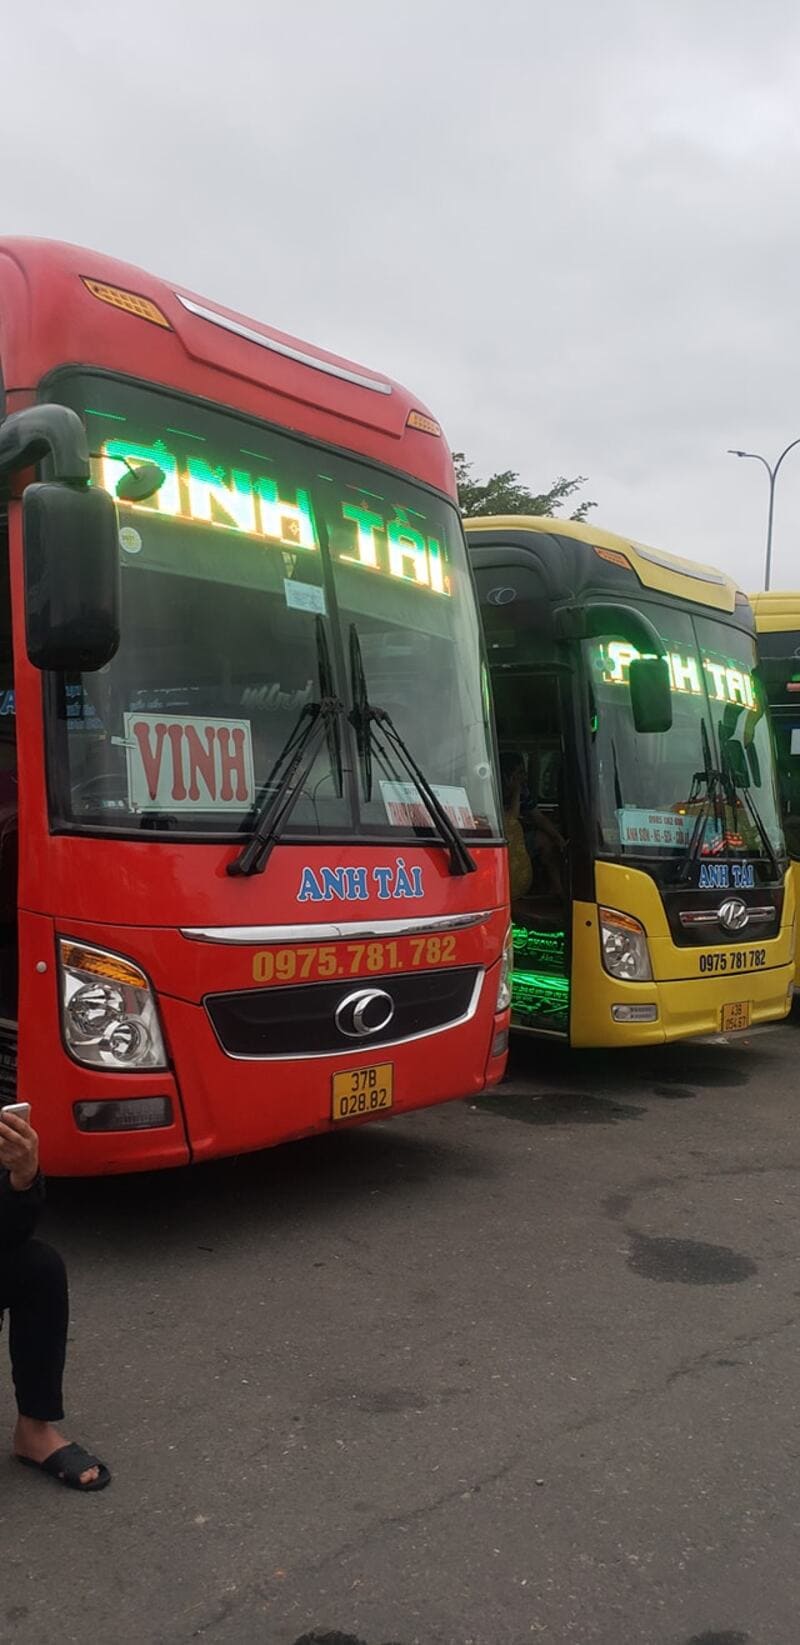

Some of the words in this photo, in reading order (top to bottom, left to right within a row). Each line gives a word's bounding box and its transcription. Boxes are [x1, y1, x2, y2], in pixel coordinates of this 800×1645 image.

[341, 502, 446, 597] TÀI
[133, 722, 249, 801] VINH
[297, 866, 369, 901] ANH
[373, 857, 424, 900] TÀI
[698, 864, 729, 888] ANH
[410, 935, 457, 966] 782
[699, 953, 727, 973] 0975
[730, 951, 747, 969] 781
[749, 949, 766, 967] 782
[351, 1069, 377, 1092] 37B
[340, 1088, 387, 1116] 028.82
